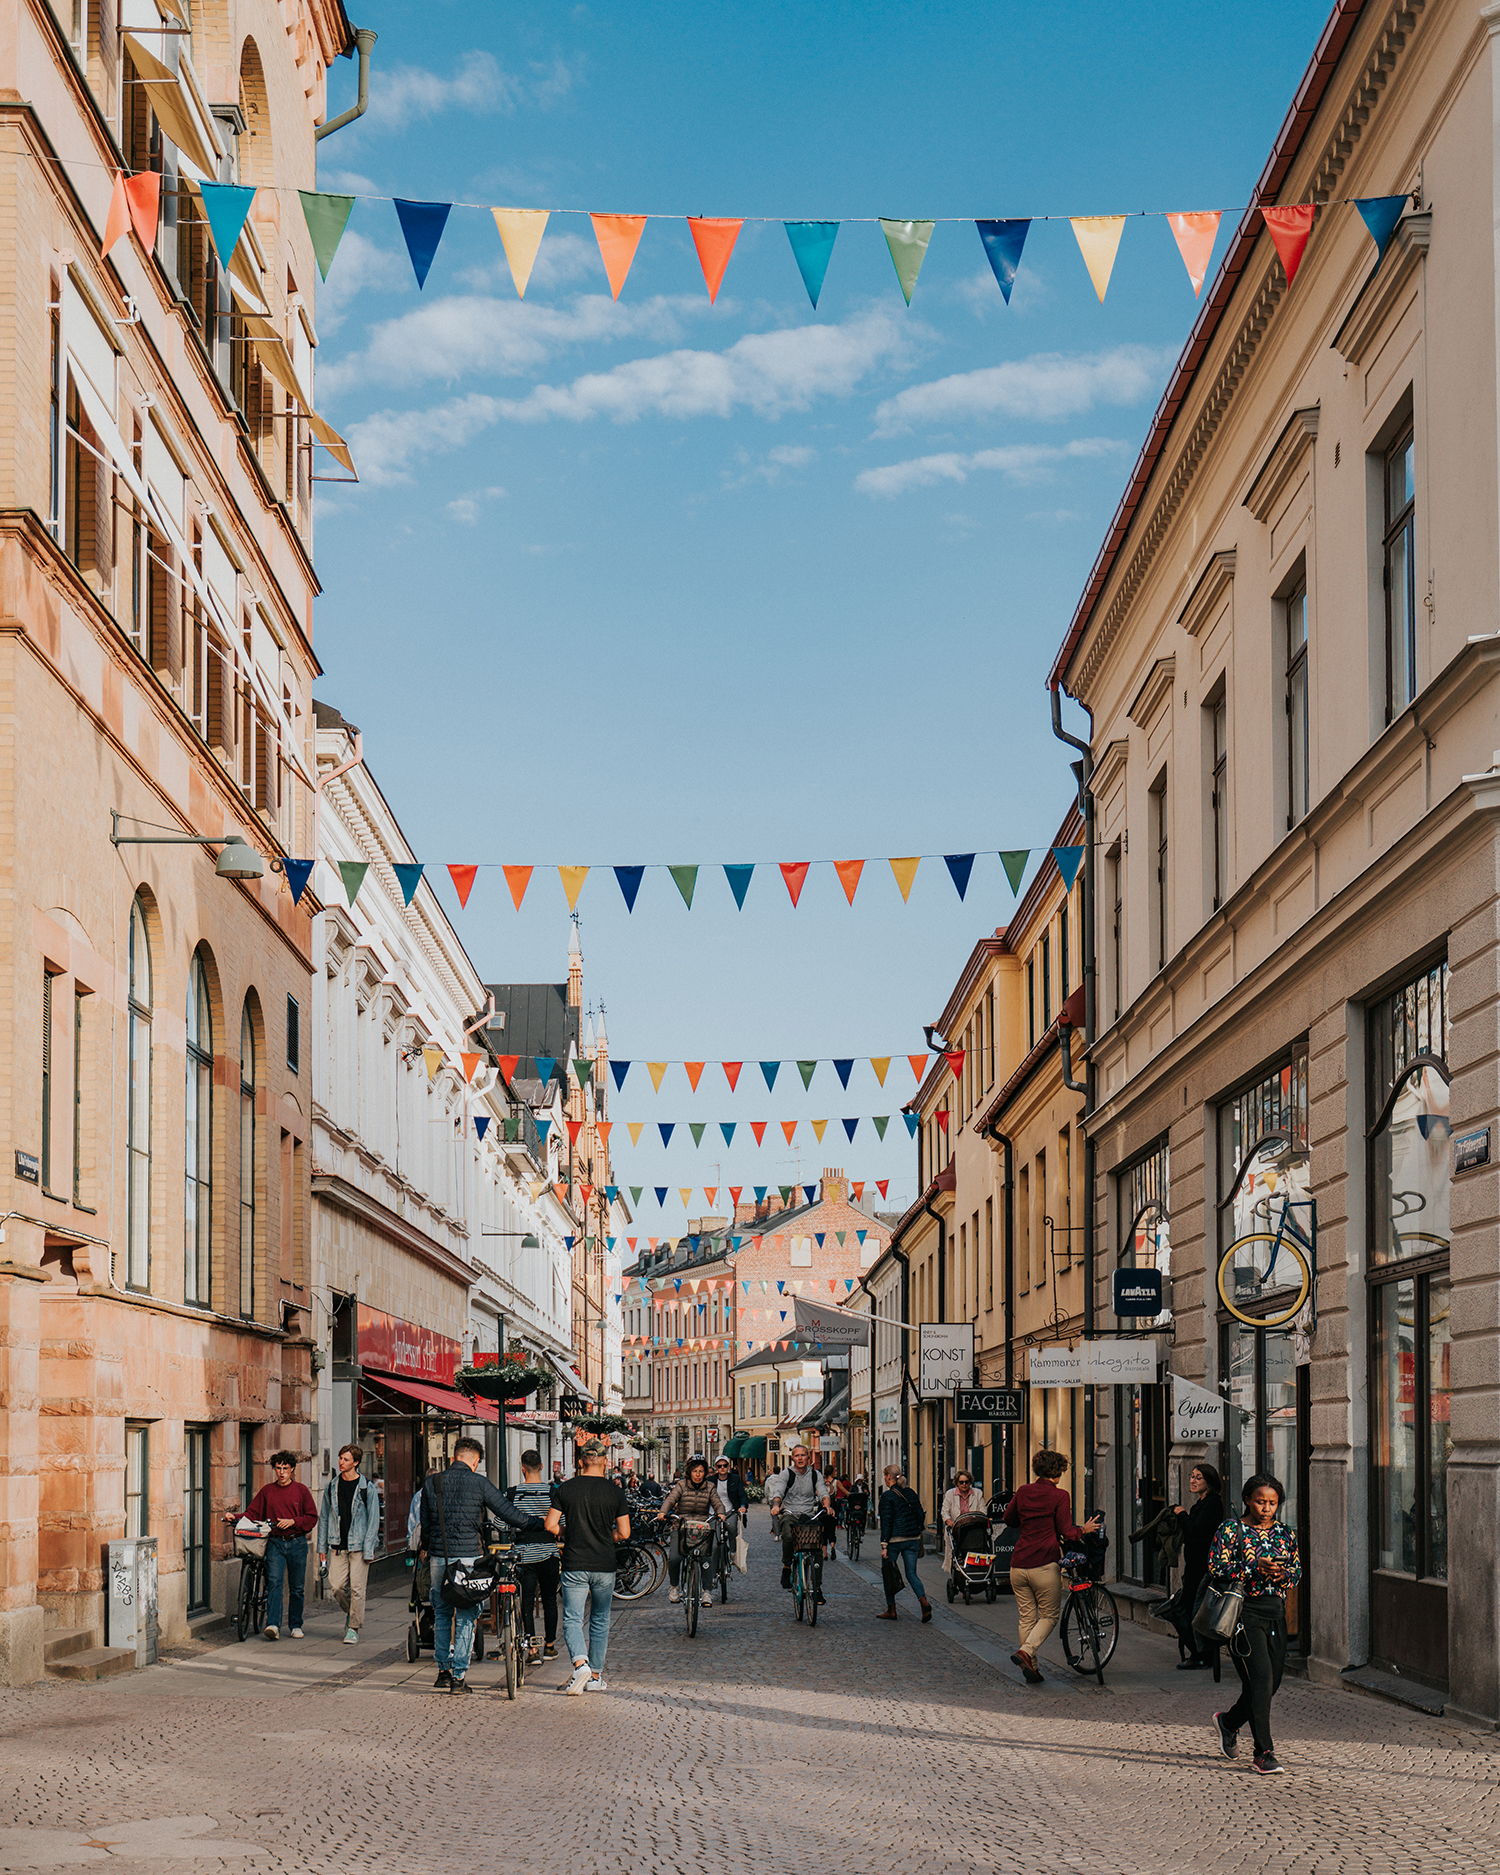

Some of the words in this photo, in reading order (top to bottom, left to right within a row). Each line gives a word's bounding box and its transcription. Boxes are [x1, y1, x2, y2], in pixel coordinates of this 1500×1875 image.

[1121, 1286, 1157, 1296] LAVAZZA
[796, 1325, 861, 1335] GROSSKOPF
[923, 1348, 966, 1361] KONST
[1087, 1351, 1151, 1373] inkognito
[923, 1363, 926, 1375] I
[923, 1378, 958, 1390] LUND
[564, 1401, 583, 1409] NOA
[960, 1395, 1017, 1411] FAGER
[1178, 1398, 1221, 1419] Cyklar
[564, 1409, 583, 1417] NOA
[1181, 1428, 1219, 1438] ÖPPET
[992, 1503, 1009, 1513] FAG
[461, 1578, 491, 1590] adid
